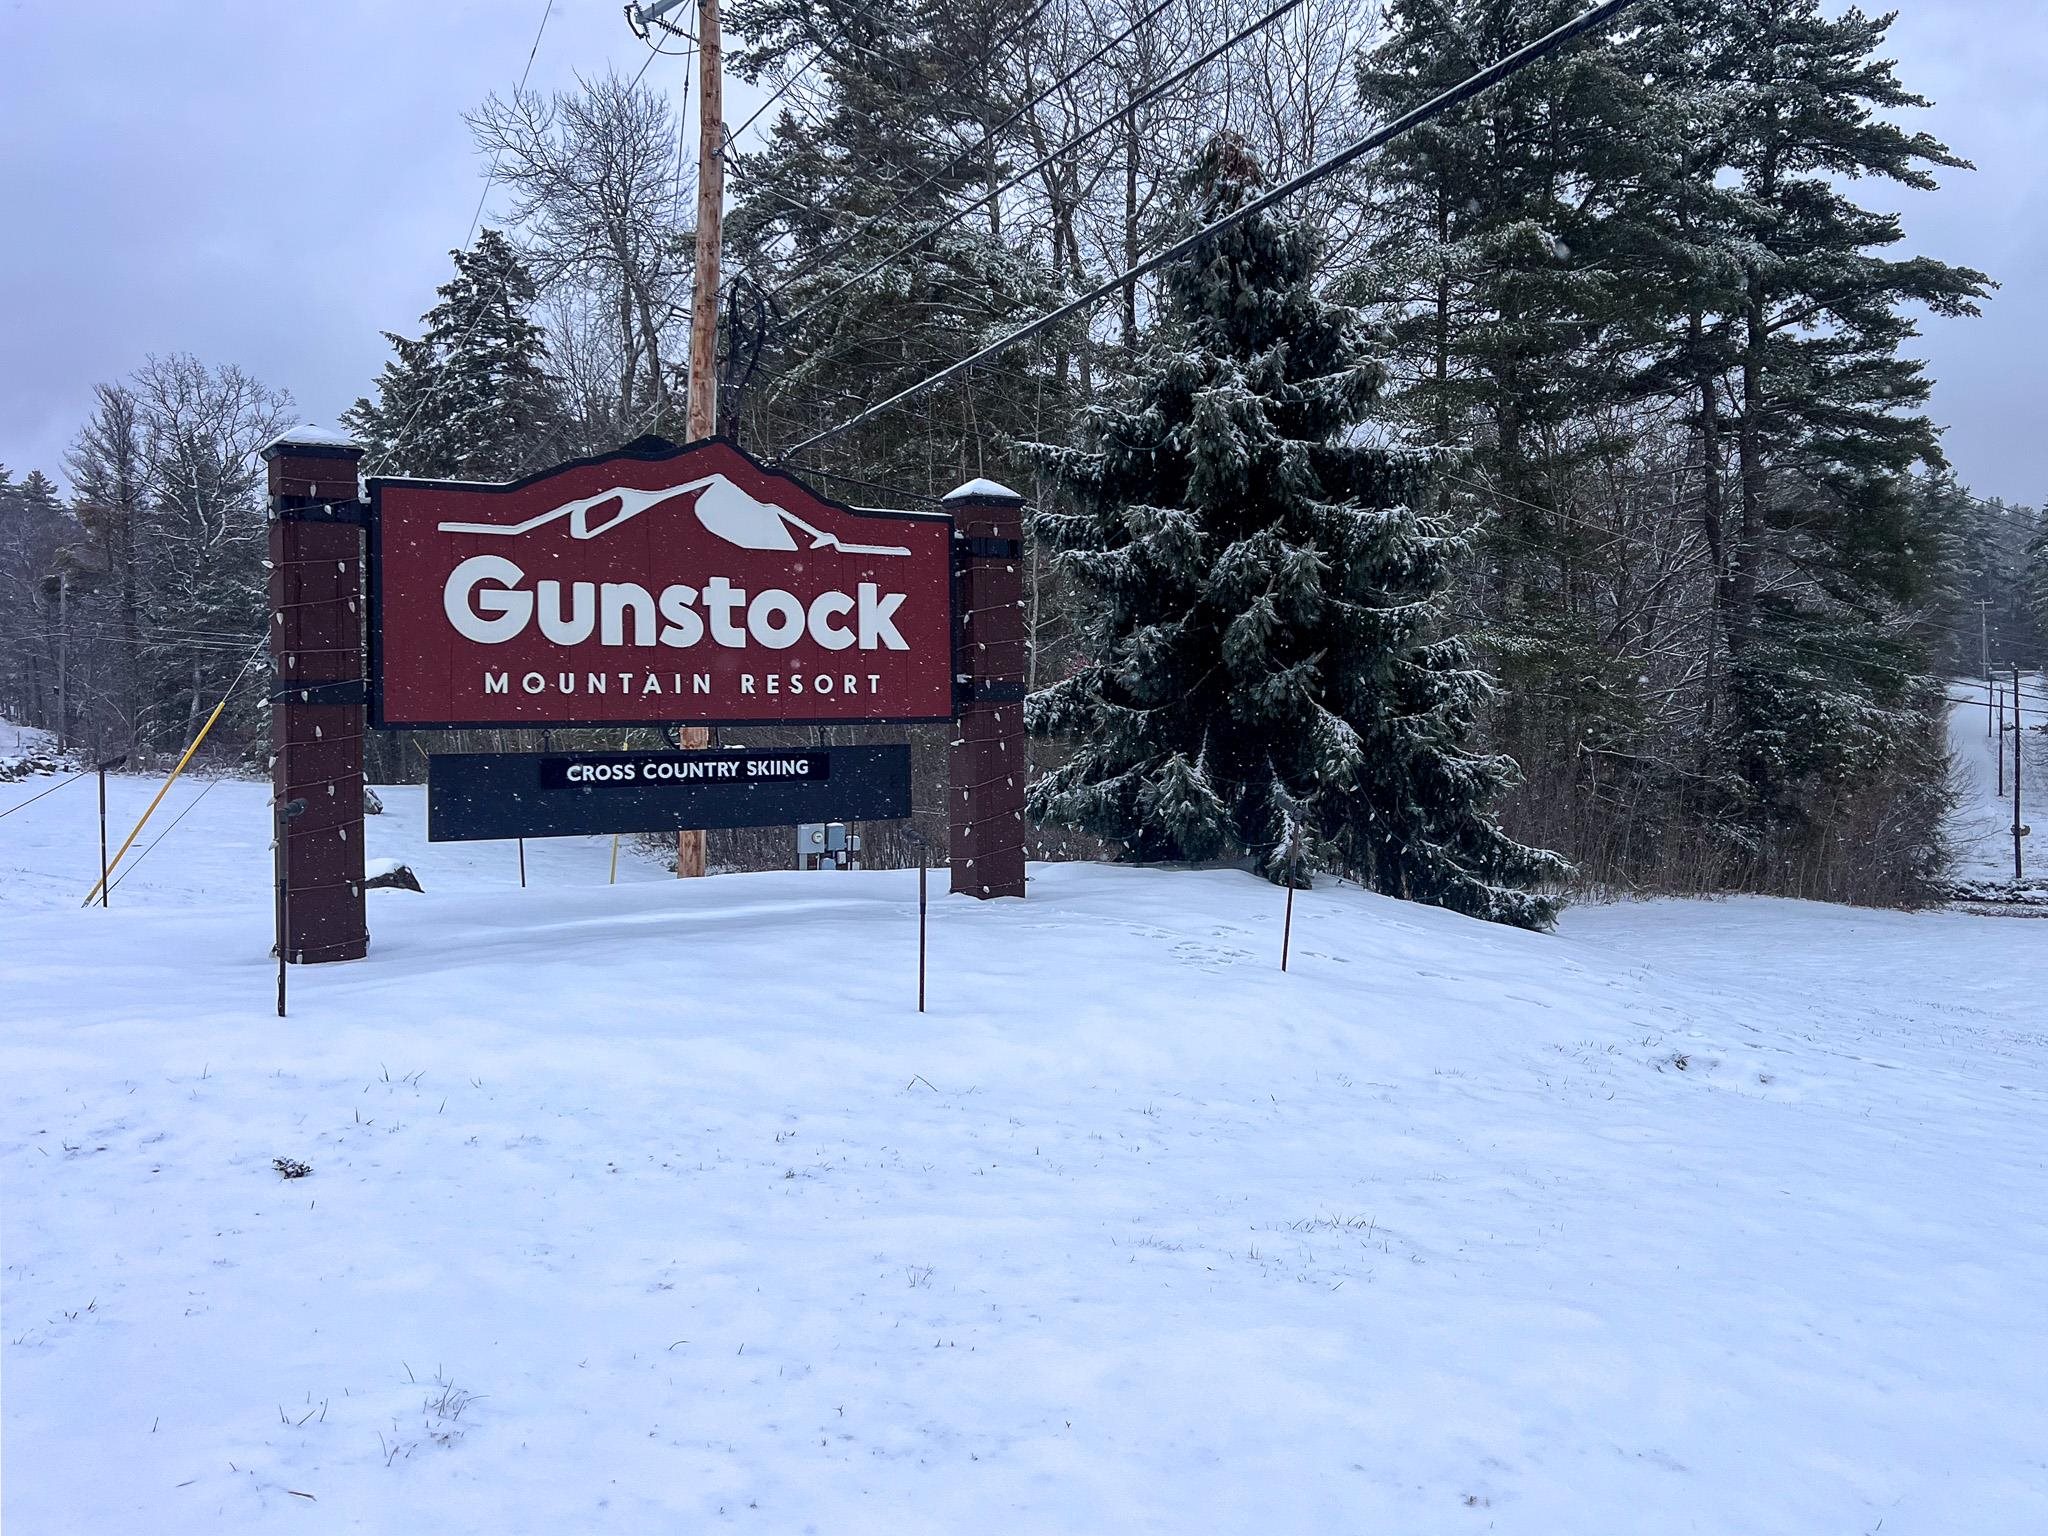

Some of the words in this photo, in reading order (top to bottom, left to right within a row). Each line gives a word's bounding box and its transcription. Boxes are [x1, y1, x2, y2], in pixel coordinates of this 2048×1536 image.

[443, 554, 911, 651] Gunstock
[484, 671, 710, 694] MOUNTAIN
[741, 673, 881, 695] RESORT
[566, 764, 636, 782] CROSS
[643, 761, 741, 780] COUNTRY
[746, 759, 809, 776] SKIING
